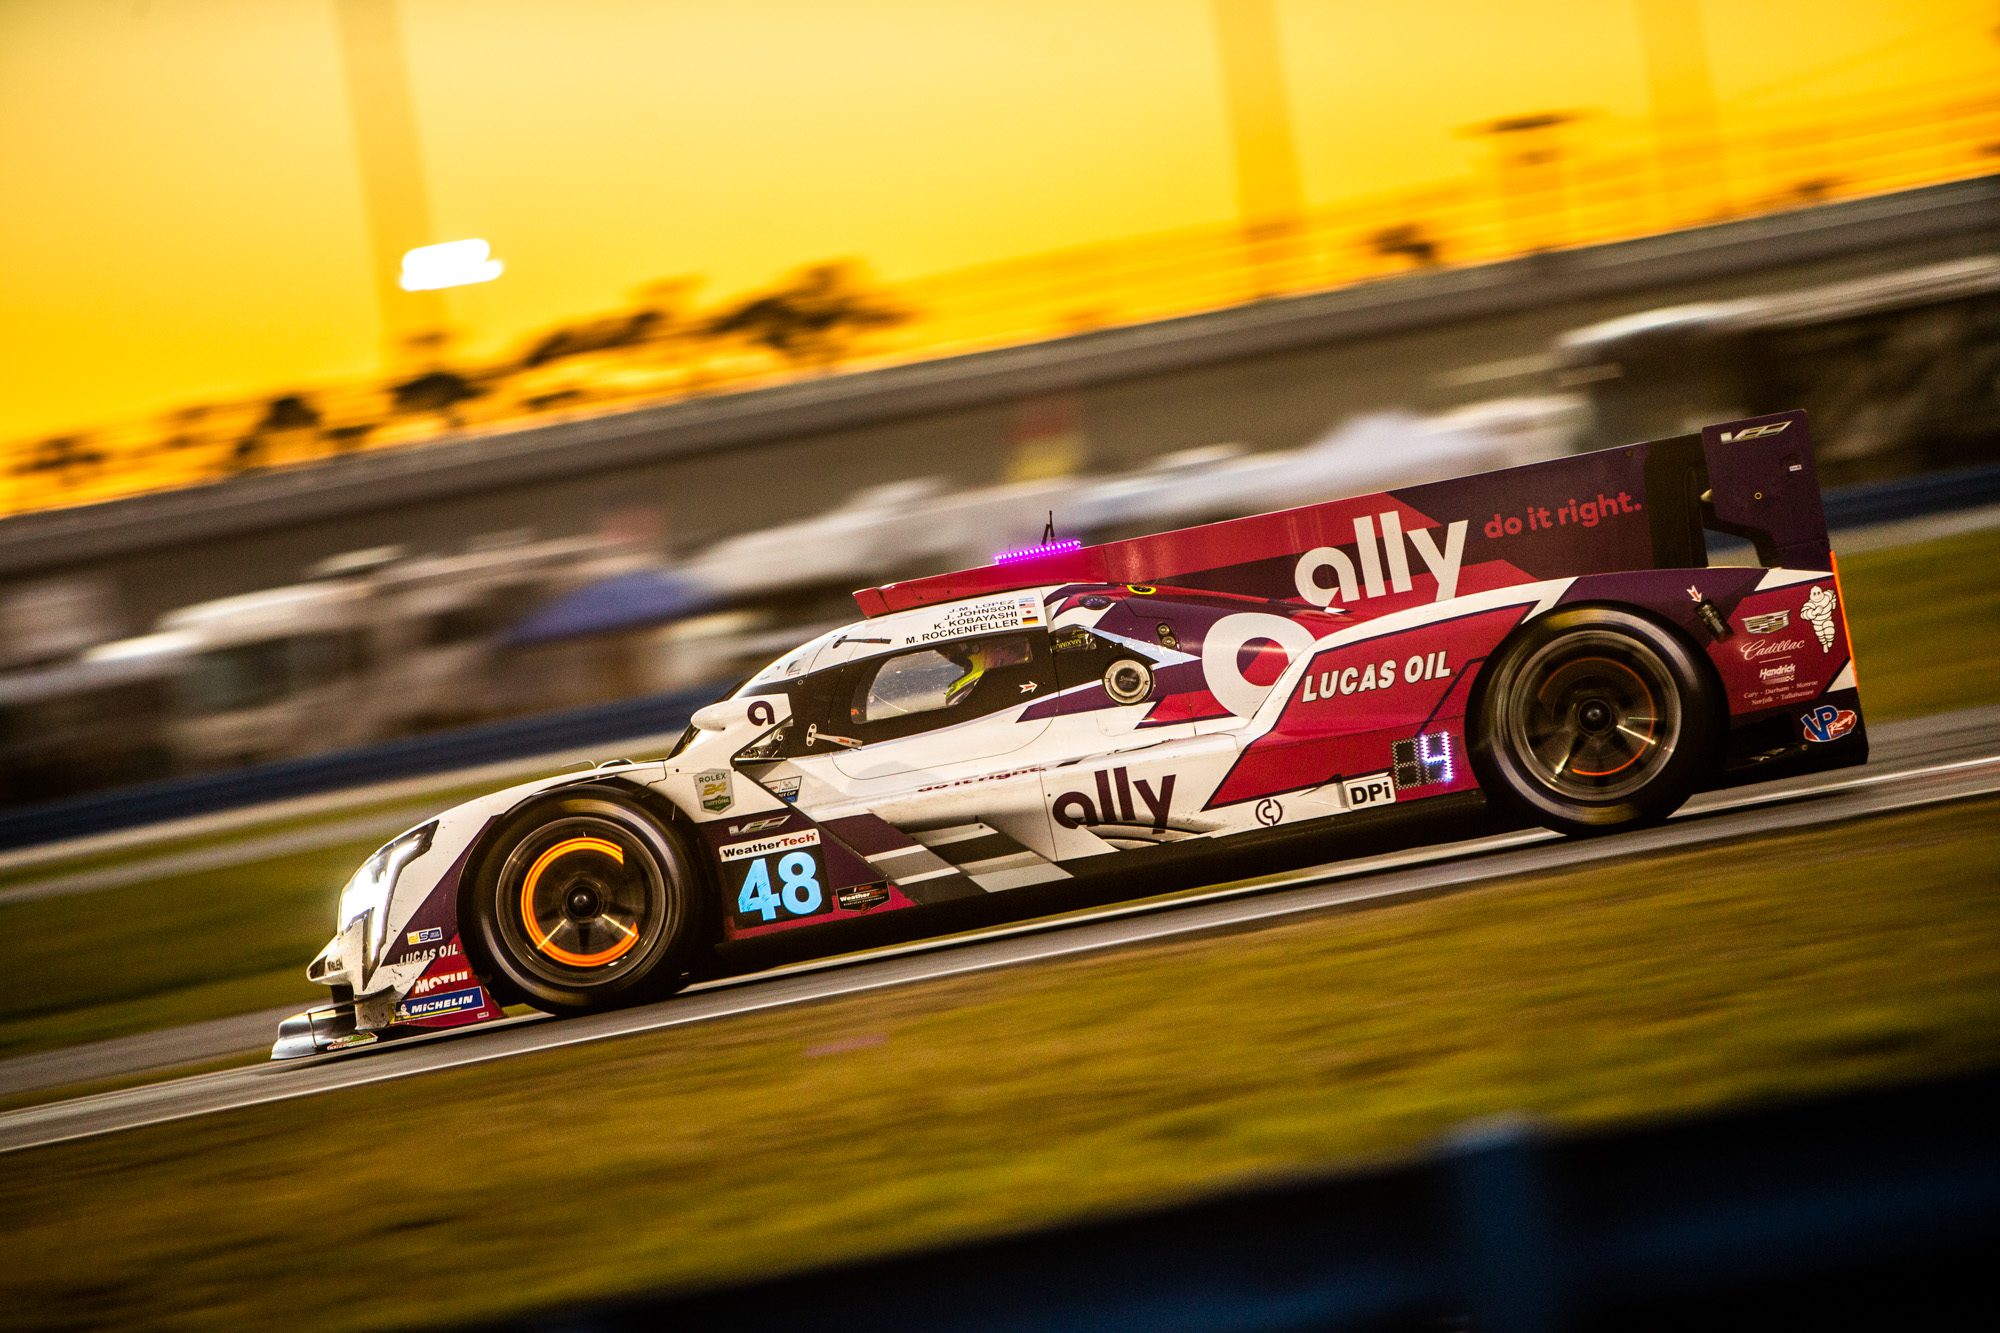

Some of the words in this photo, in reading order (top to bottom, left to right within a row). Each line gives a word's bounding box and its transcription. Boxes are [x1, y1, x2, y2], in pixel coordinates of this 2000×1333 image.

[1484, 514, 1522, 539] do
[1527, 505, 1553, 531] it
[1558, 491, 1643, 528] right.
[1295, 510, 1468, 611] ally
[957, 604, 1016, 618] JOHNSON
[975, 599, 1015, 609] LOPEZ
[949, 611, 1018, 627] KOBAYASHI
[905, 635, 919, 644] M.
[921, 619, 1019, 641] ROCKENFELLER
[1740, 639, 1805, 660] Cadillac
[1302, 660, 1397, 702] LUCAS
[1404, 651, 1451, 684] OIL
[1759, 664, 1796, 680] Hendrick
[747, 700, 775, 726] a
[1800, 705, 1839, 741] VP
[699, 773, 727, 784] ROLEX
[1052, 766, 1177, 835] ally
[1350, 782, 1391, 805] DPi
[723, 832, 816, 858] WeatherTech
[738, 852, 822, 921] 48
[400, 948, 436, 965] LUCAS
[439, 943, 459, 958] OIL
[411, 995, 474, 1014] MICHELIN
